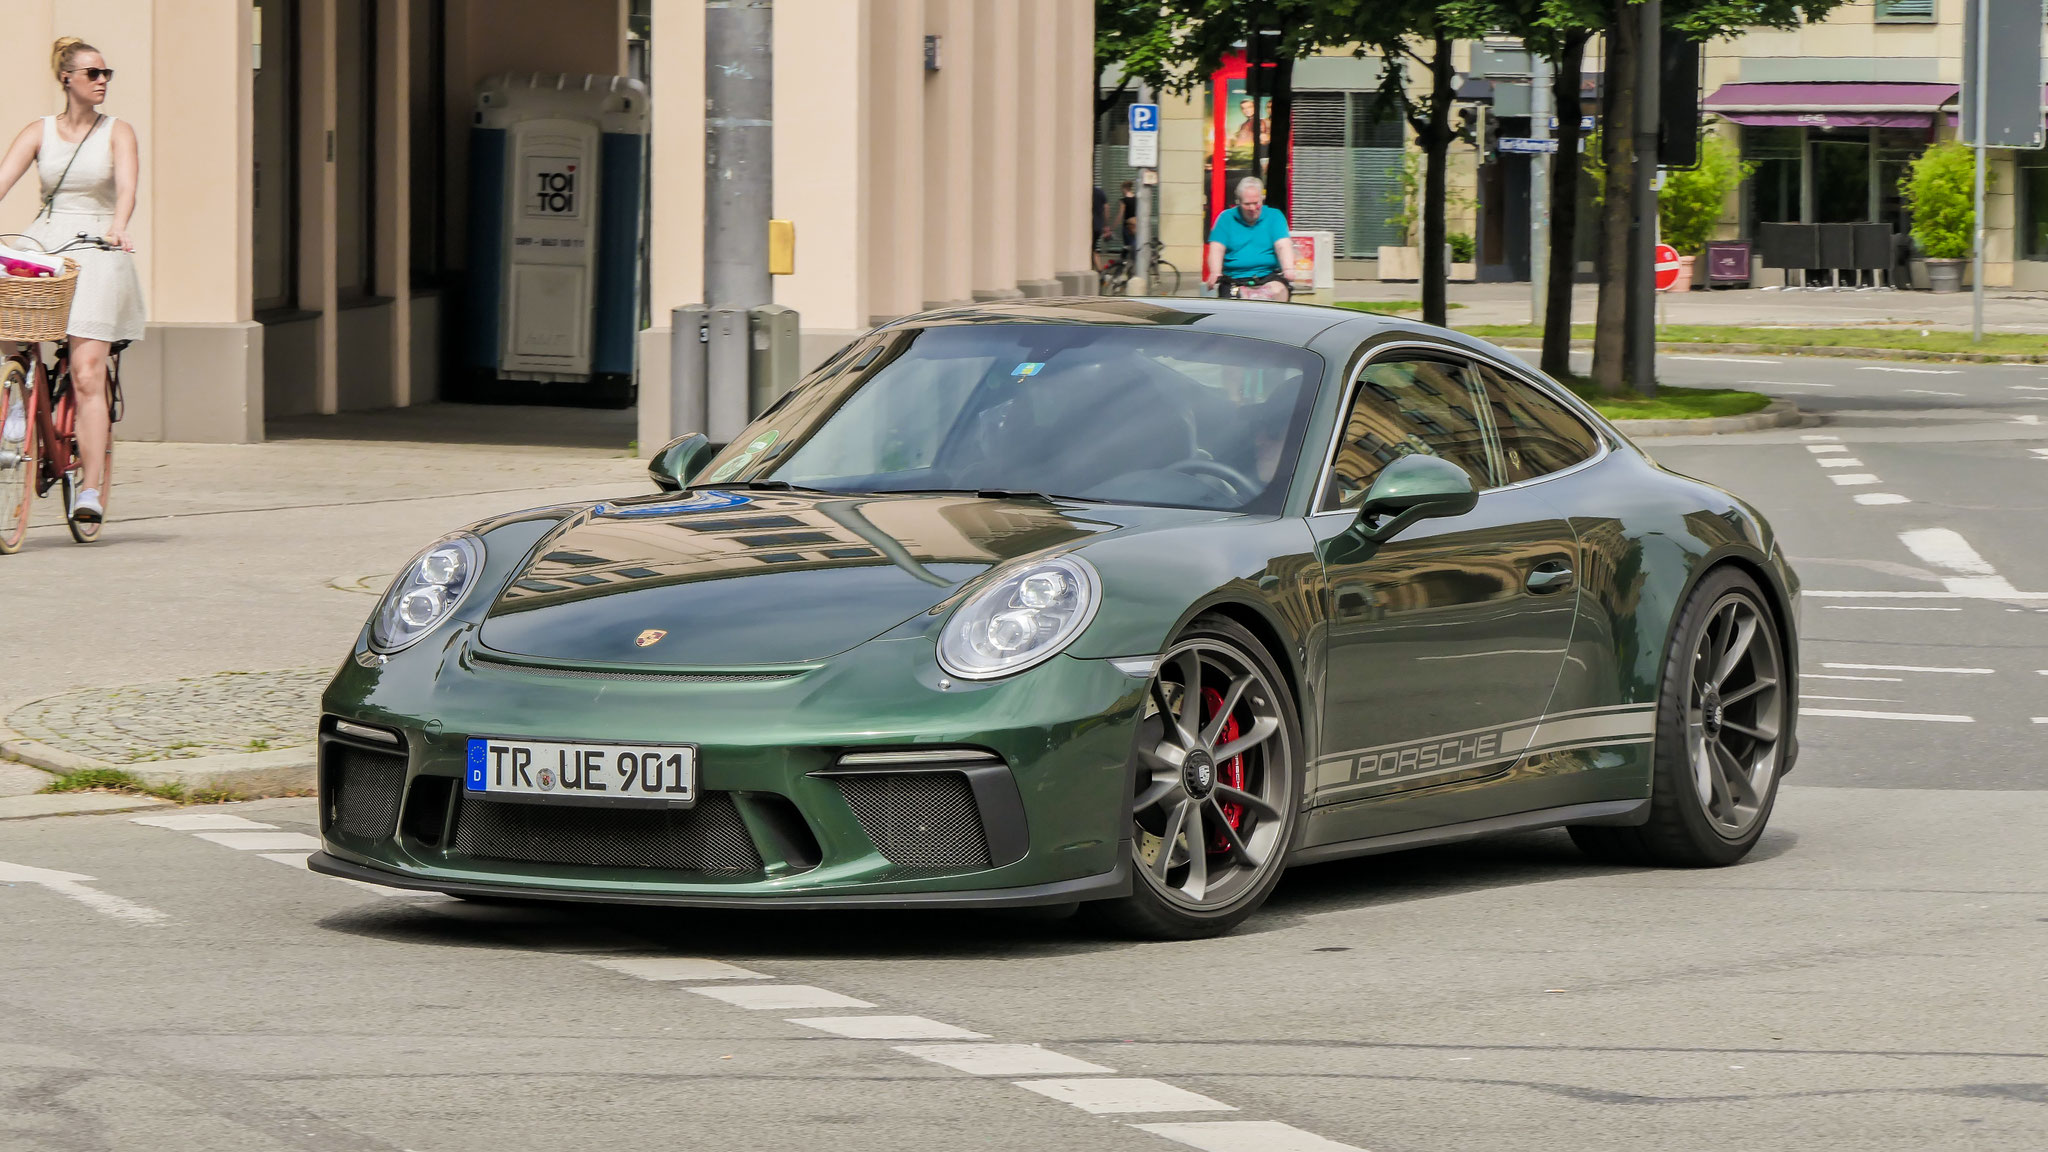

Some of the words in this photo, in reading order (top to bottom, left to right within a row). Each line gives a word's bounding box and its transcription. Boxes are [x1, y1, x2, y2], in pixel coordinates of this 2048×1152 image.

[1134, 107, 1151, 129] P
[537, 172, 574, 192] TOI
[536, 192, 573, 212] TOI
[1356, 733, 1497, 780] PORSCHE
[473, 769, 481, 782] D
[489, 745, 533, 788] TR
[559, 749, 607, 791] UE
[616, 751, 688, 793] 901
